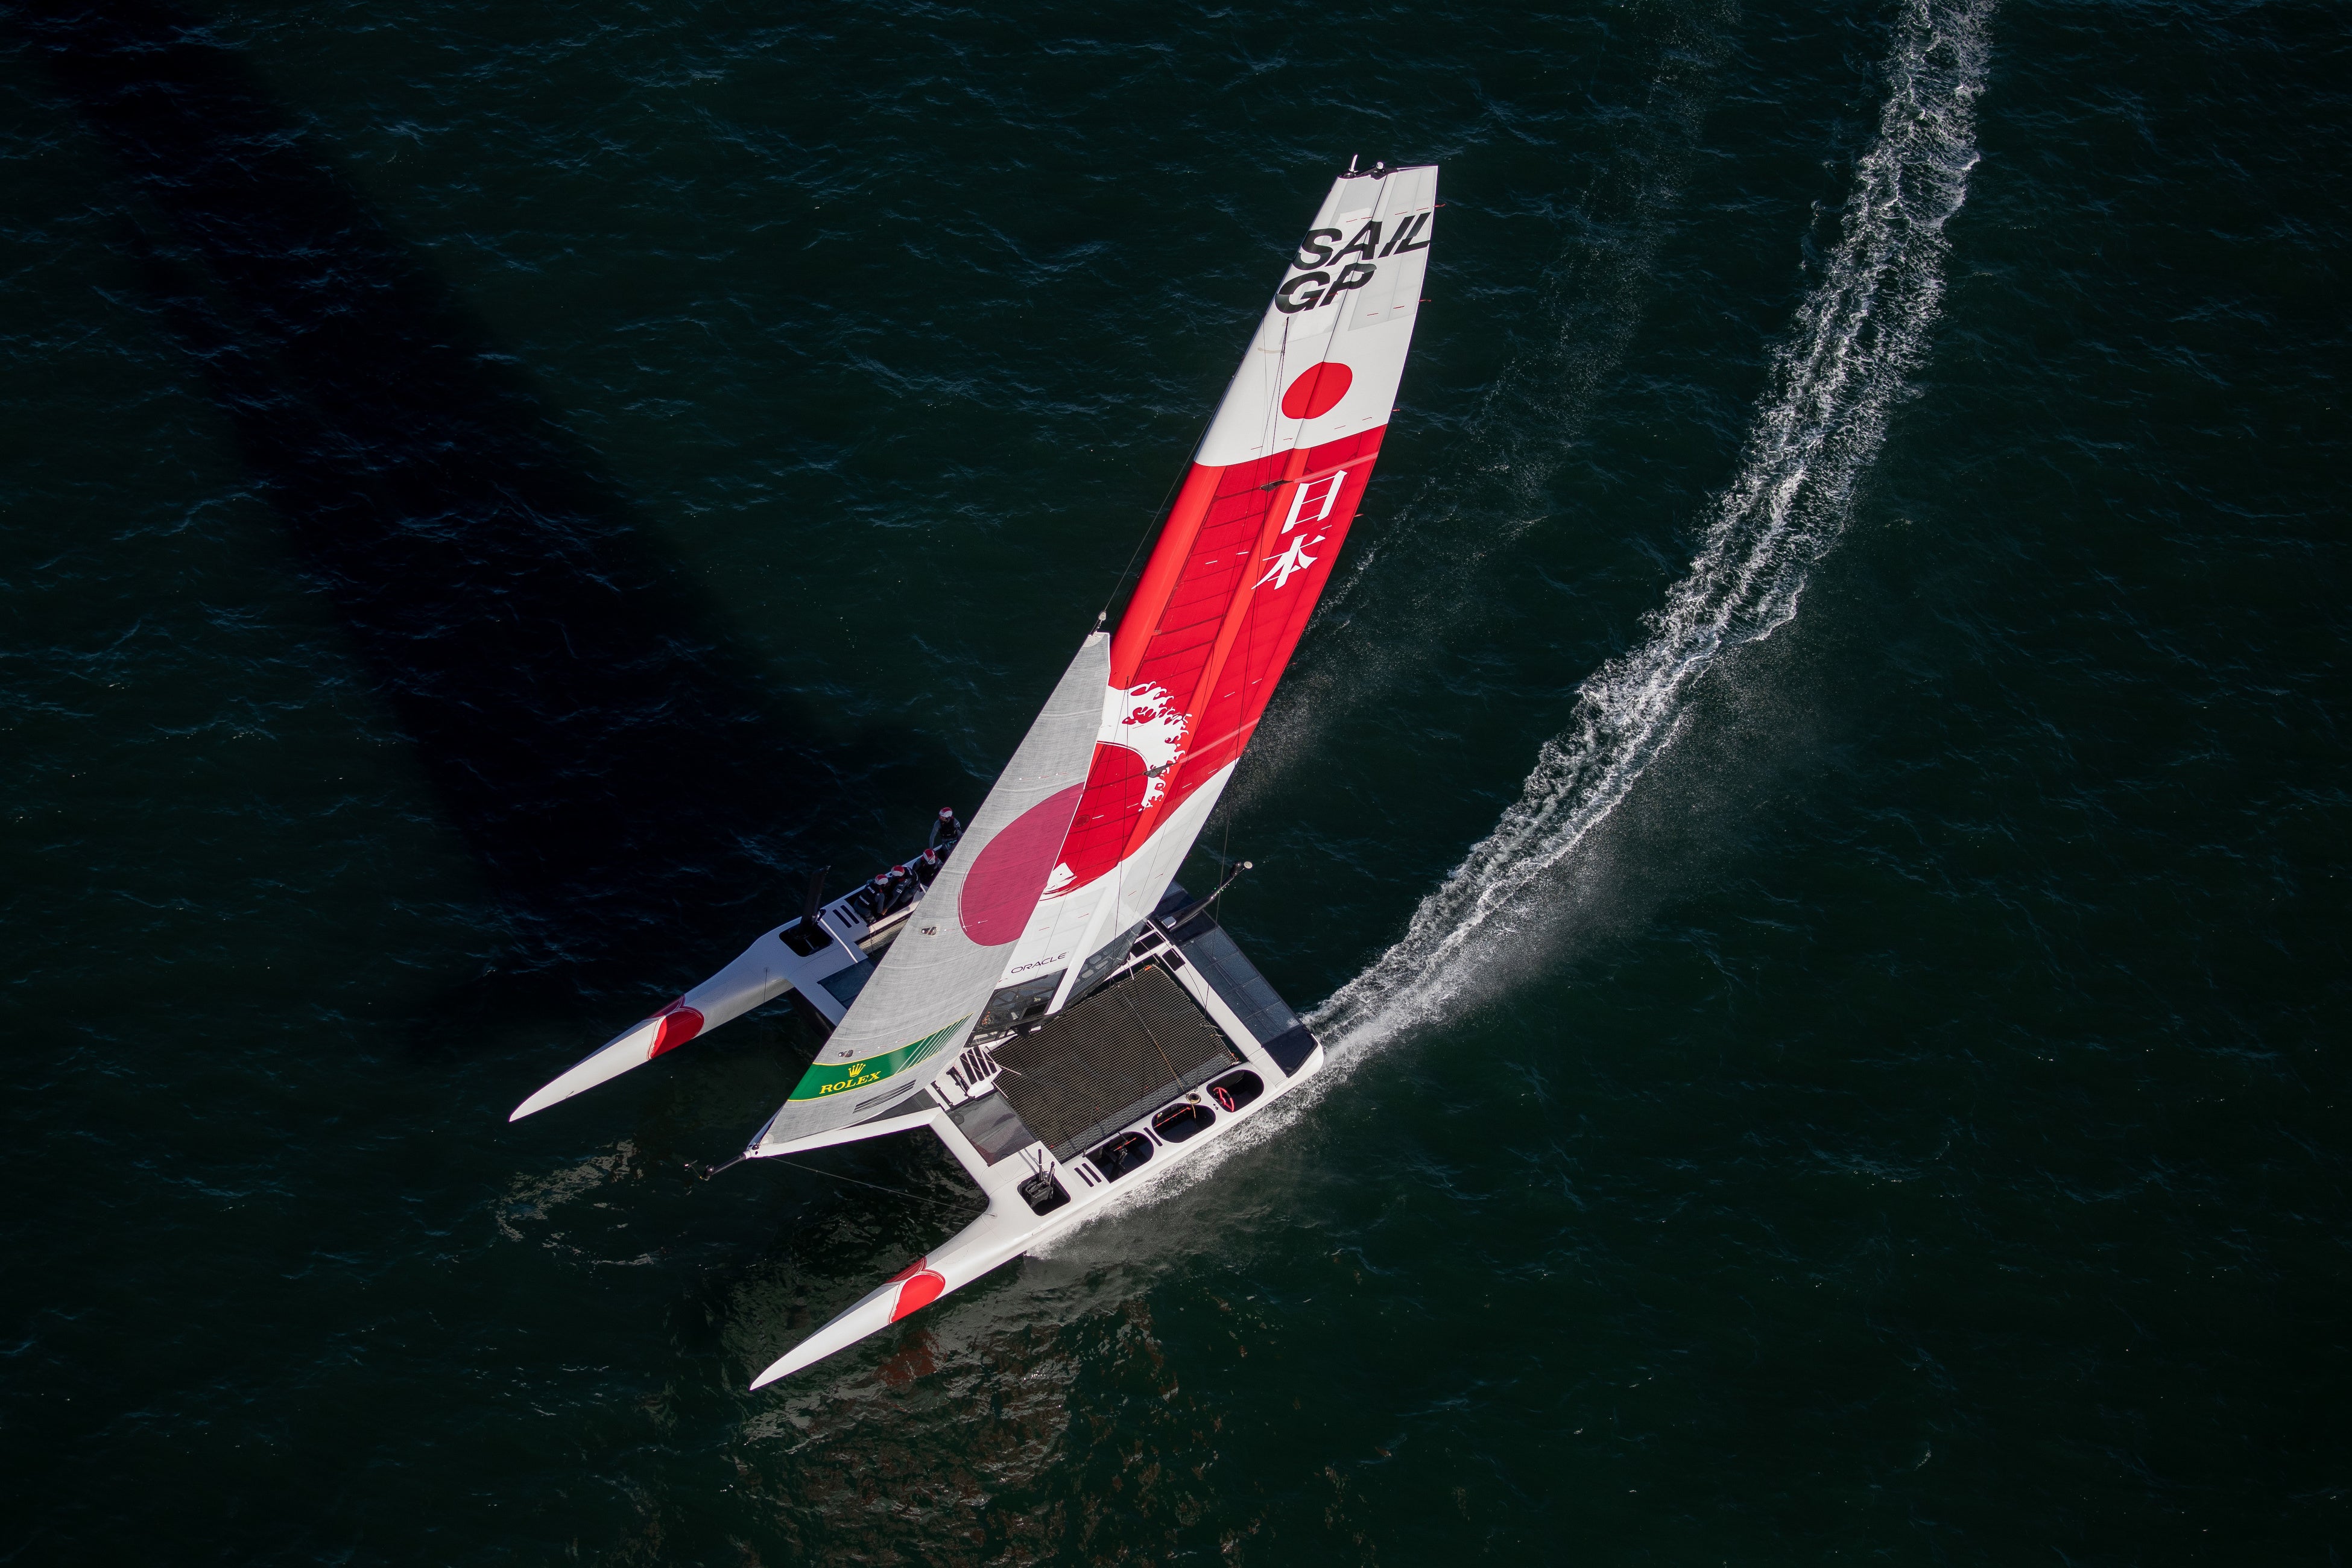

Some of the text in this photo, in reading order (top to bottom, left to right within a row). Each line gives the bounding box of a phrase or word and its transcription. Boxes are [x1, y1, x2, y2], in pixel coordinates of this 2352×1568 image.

[1292, 212, 1432, 271] SAIL
[1274, 263, 1377, 314] GP
[1251, 470, 1348, 590] 日本
[1011, 951, 1067, 974] ORACLE
[819, 1070, 882, 1095] ROLEX
